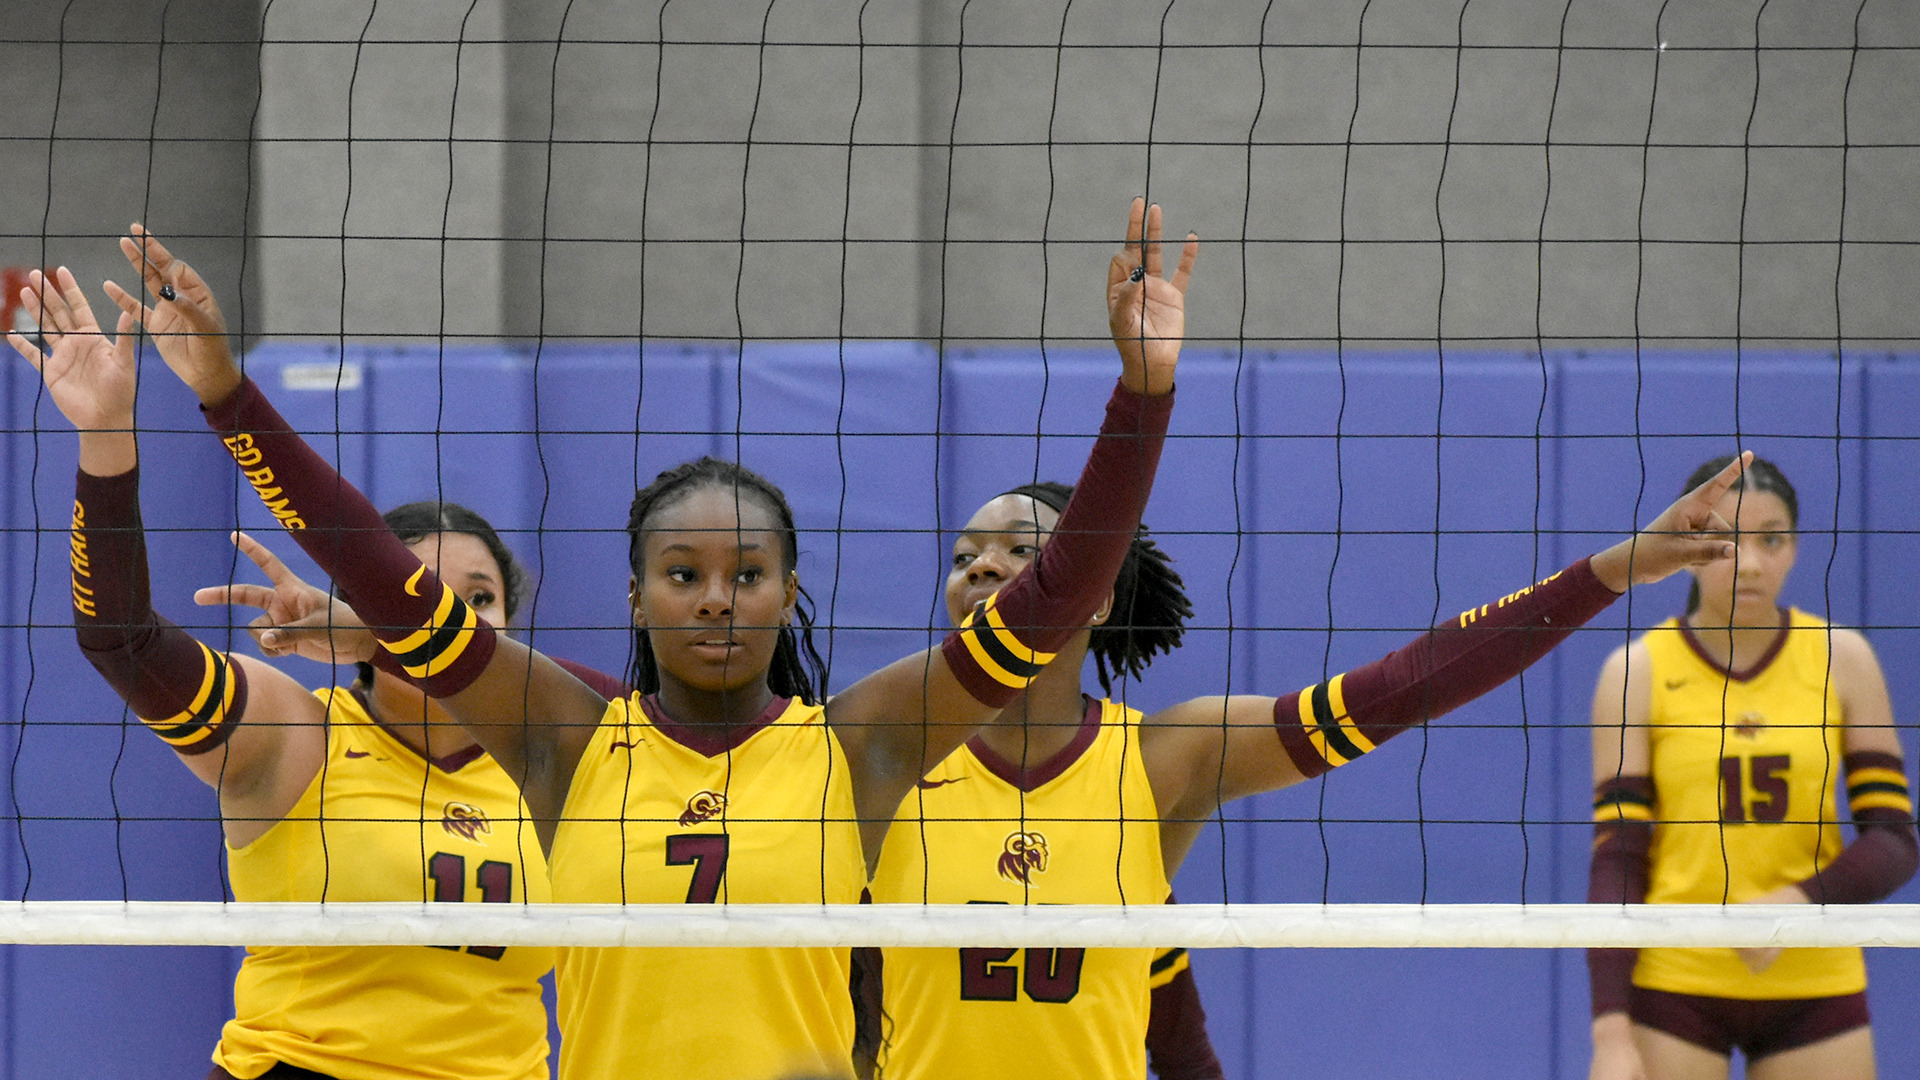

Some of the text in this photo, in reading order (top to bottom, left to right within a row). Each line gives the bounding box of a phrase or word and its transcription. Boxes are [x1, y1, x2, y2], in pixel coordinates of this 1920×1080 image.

[223, 432, 307, 534] GO RAMS
[70, 499, 97, 617] HT RAMS
[1717, 753, 1790, 826] 15
[424, 851, 512, 961] 11
[665, 833, 730, 904] 7
